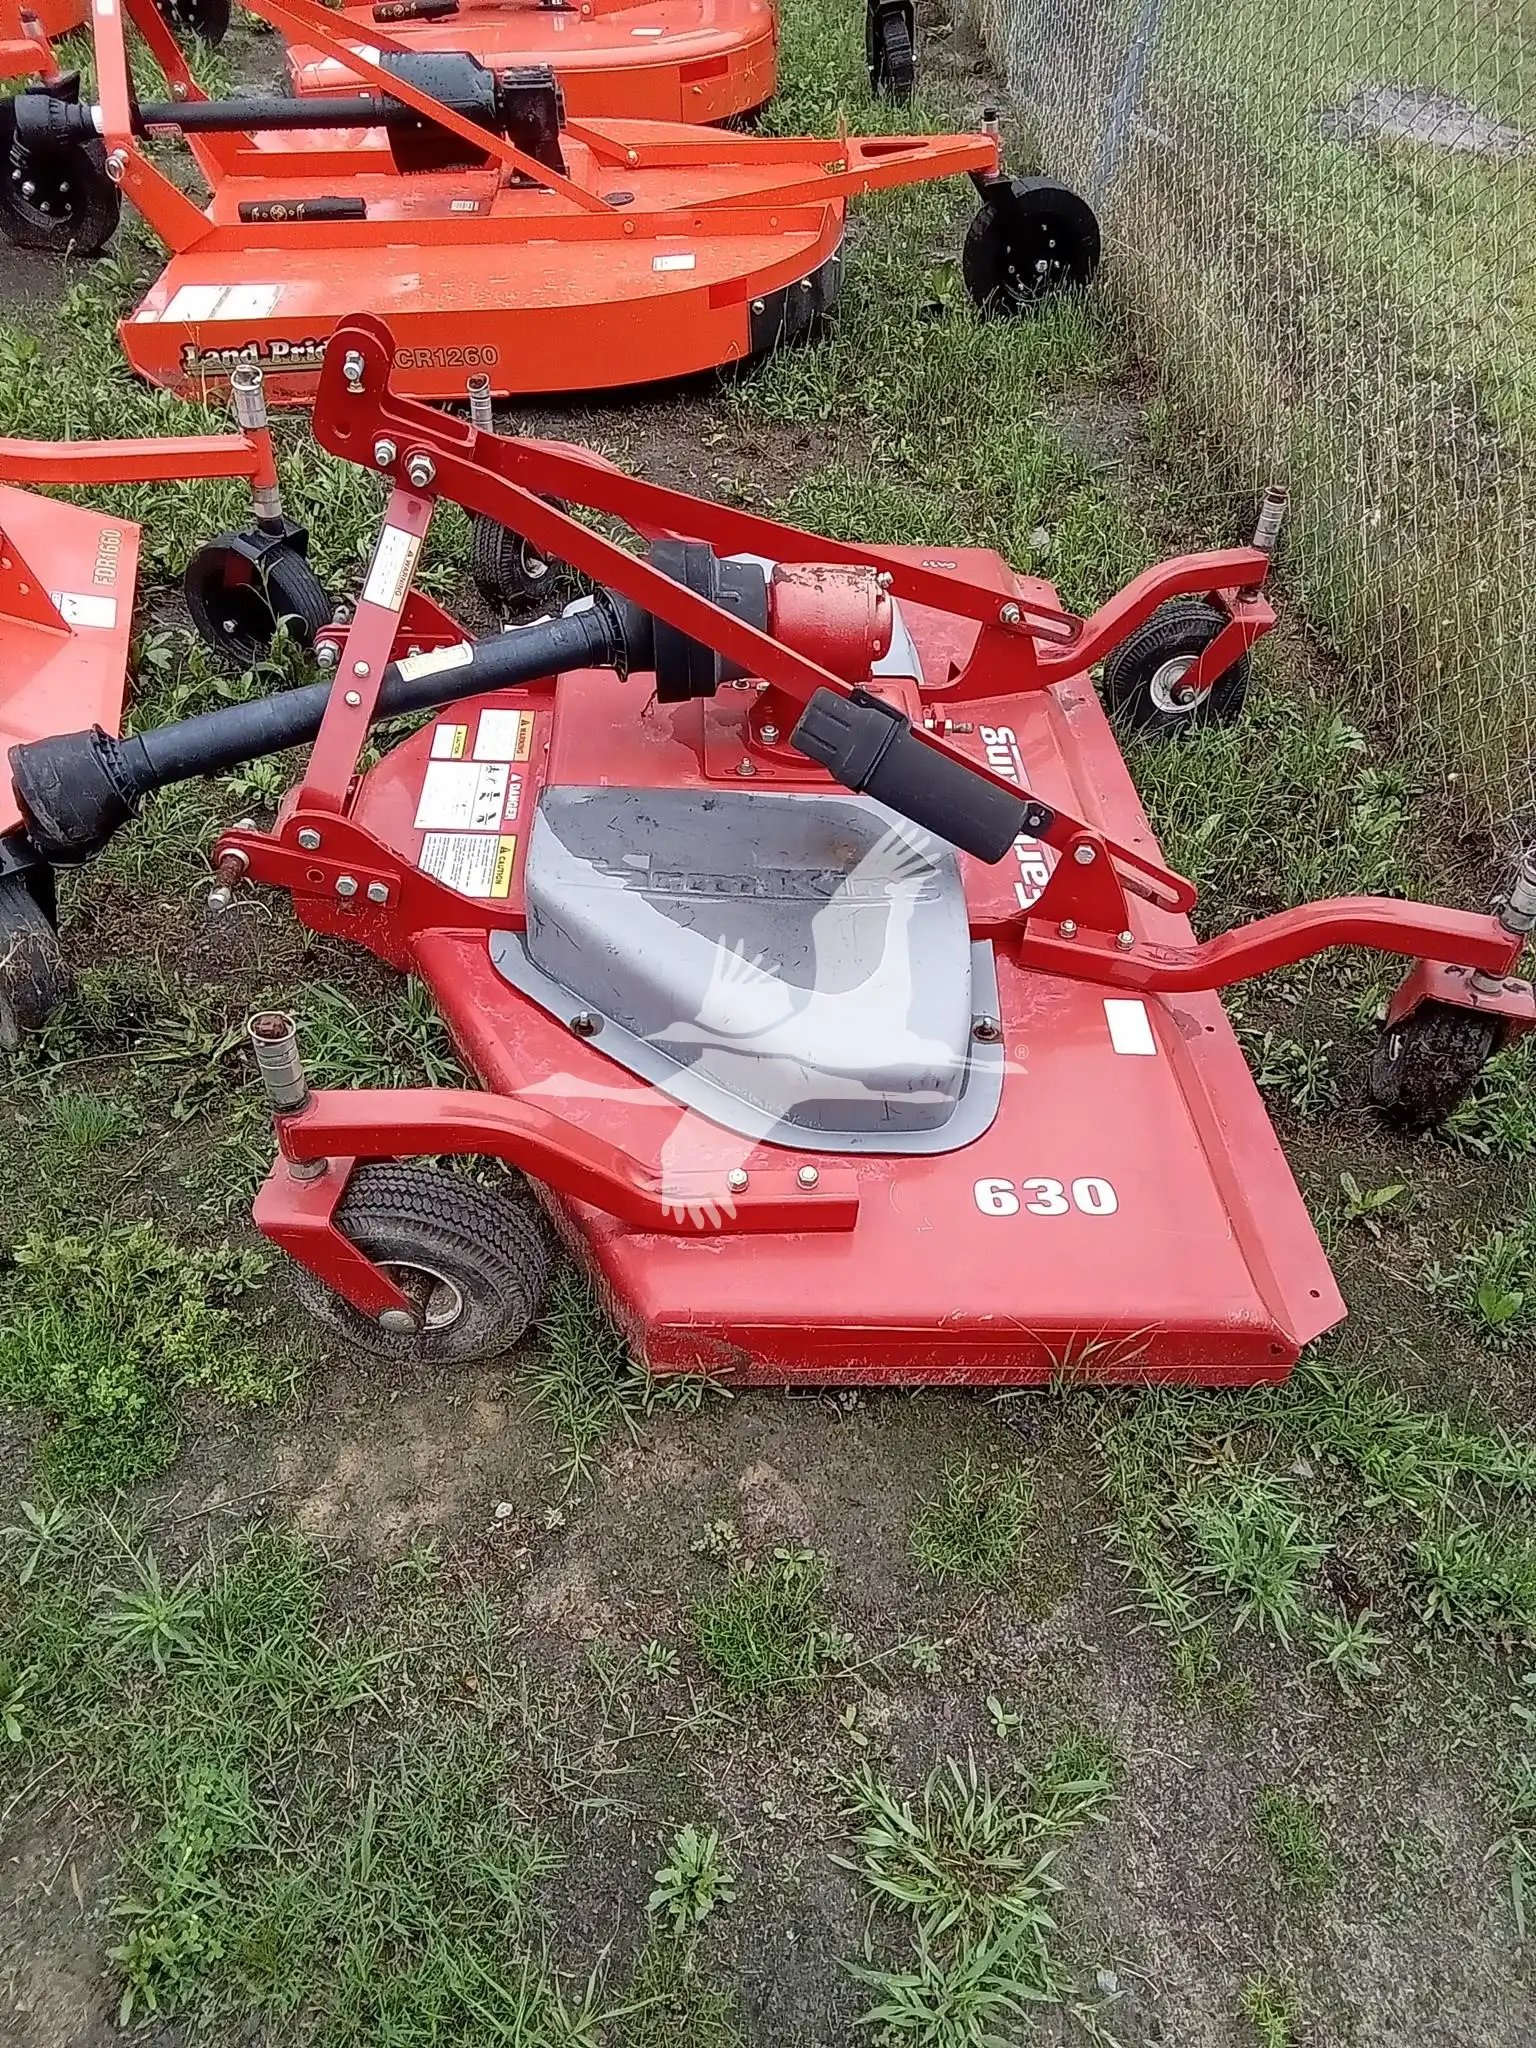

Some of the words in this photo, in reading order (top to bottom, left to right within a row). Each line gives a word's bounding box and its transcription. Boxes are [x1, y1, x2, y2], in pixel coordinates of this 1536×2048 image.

[182, 341, 260, 367] Land
[392, 346, 498, 369] CR1260
[92, 528, 122, 587] FDR1660
[394, 559, 413, 597] WARNING
[516, 726, 528, 755] WARNING
[503, 782, 521, 821] DANGER
[495, 854, 507, 886] CAUTION
[972, 1176, 1120, 1217] 630
